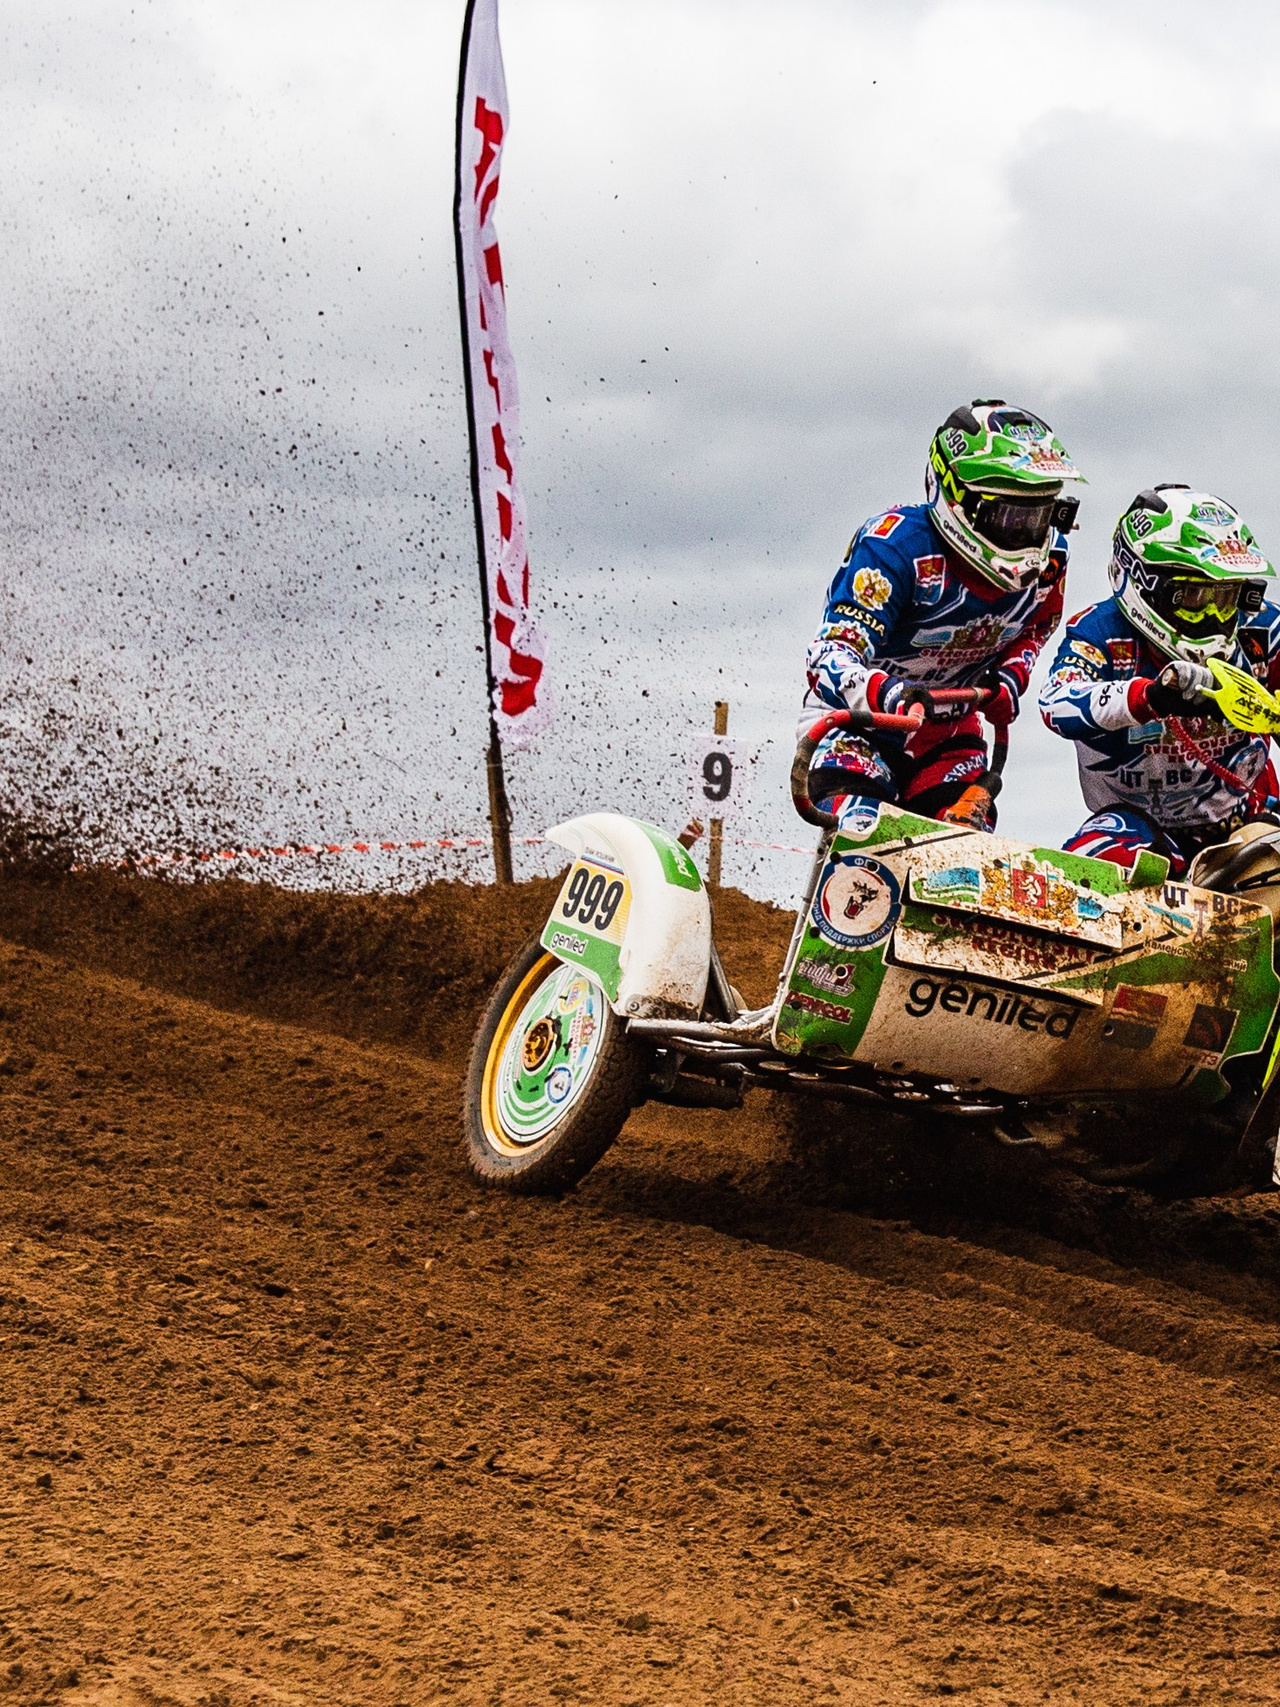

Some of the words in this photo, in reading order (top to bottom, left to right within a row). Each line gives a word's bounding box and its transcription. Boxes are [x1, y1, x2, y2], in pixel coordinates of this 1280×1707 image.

[945, 427, 967, 458] 999
[943, 518, 977, 553] geniled
[1130, 509, 1152, 537] 999
[834, 604, 886, 637] RUSSIA
[1131, 606, 1166, 640] geniled
[702, 752, 732, 801] 9
[562, 867, 624, 931] 999
[551, 931, 587, 954] geniled
[905, 977, 1080, 1038] geniled
